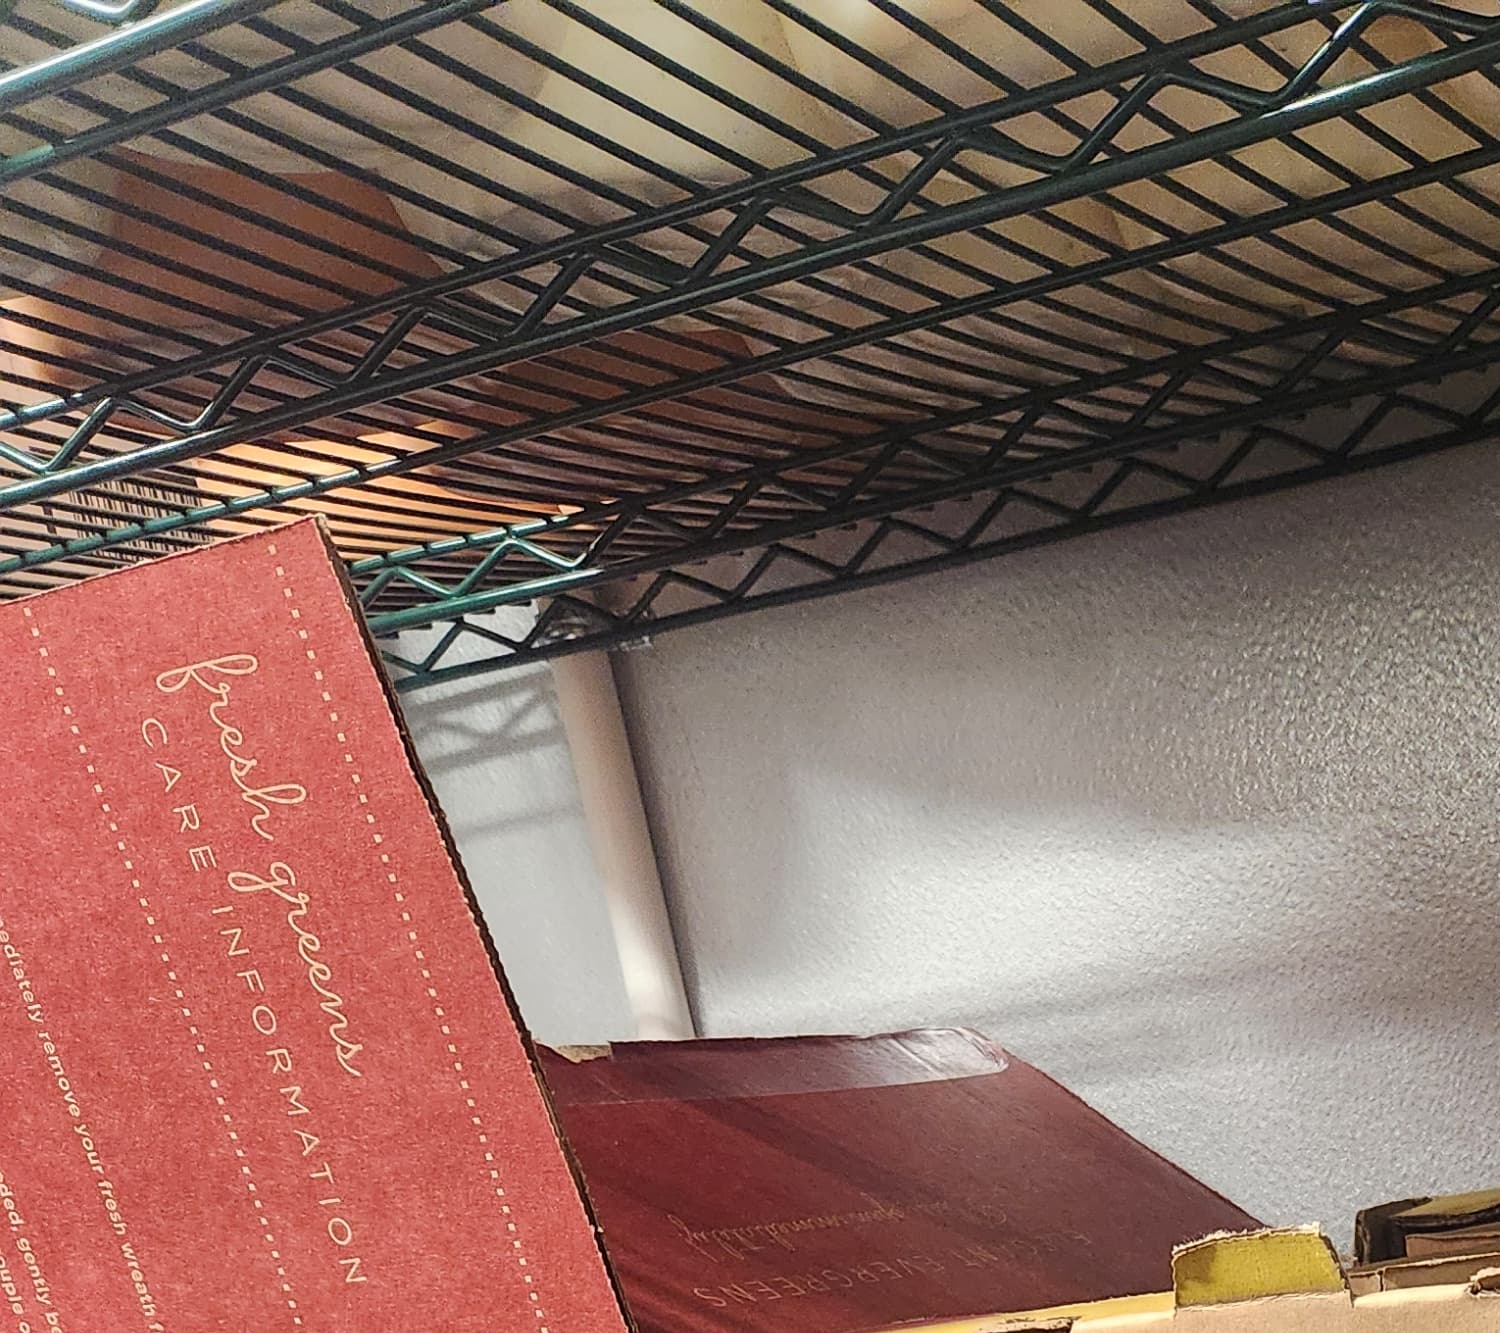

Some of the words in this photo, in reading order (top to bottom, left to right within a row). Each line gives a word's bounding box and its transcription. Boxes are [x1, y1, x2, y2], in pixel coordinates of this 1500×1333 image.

[156, 654, 307, 841] fresh
[141, 717, 218, 872] CARE
[212, 904, 368, 1285] INFORMATION
[227, 861, 364, 1076] greens
[16, 1238, 51, 1305] gently
[38, 1031, 82, 1118] remove
[74, 1123, 104, 1174] your
[98, 1180, 127, 1235] fresh
[120, 1241, 156, 1317] wreath
